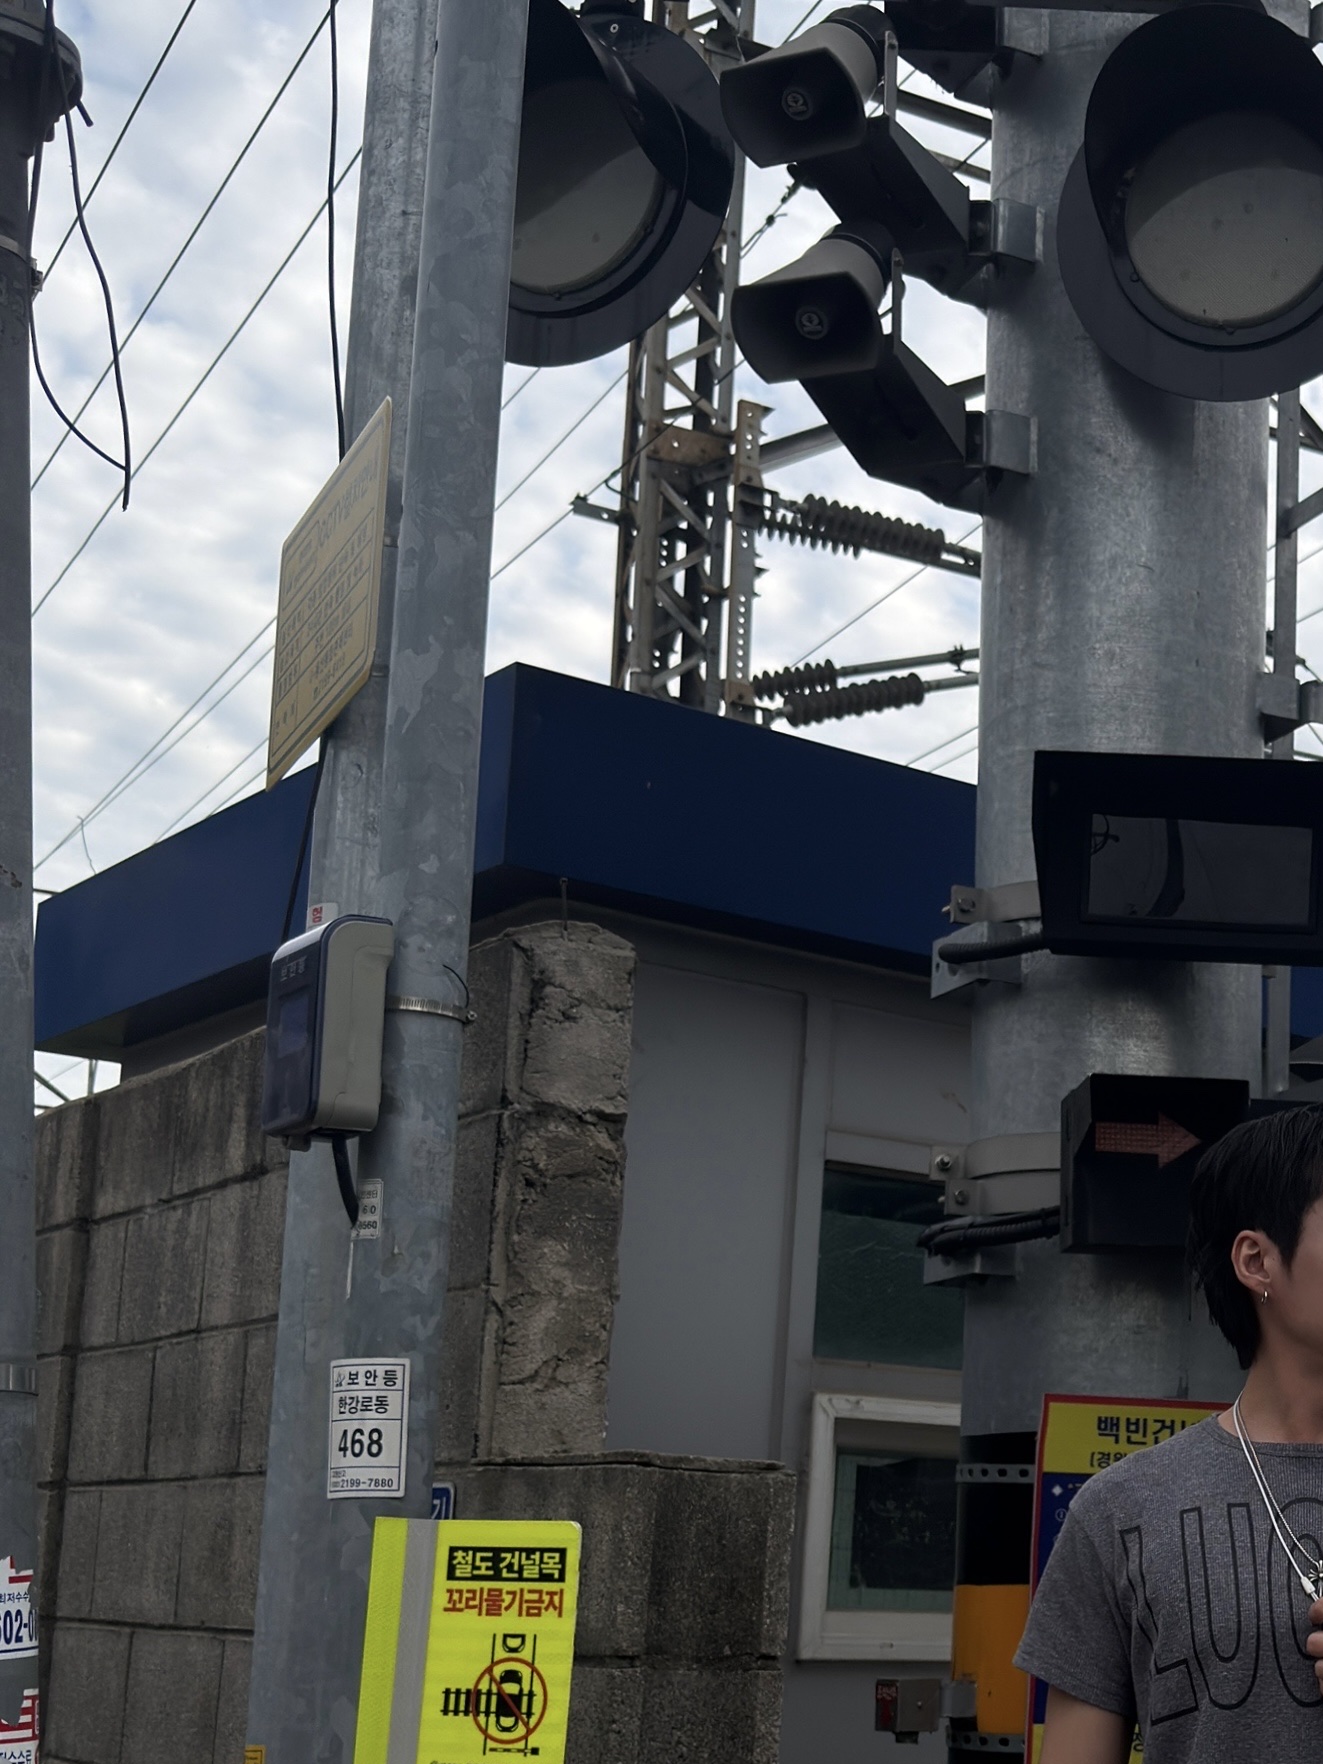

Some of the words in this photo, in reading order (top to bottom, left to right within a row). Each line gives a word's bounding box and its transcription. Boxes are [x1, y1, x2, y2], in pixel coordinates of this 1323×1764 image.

[347, 1369, 398, 1387] 보안등
[338, 1395, 389, 1414] 한강로동
[338, 1428, 383, 1458] 468
[1097, 1416, 1201, 1445] 백빈건
[452, 1550, 495, 1578] 철도
[499, 1551, 562, 1579] 건널목
[443, 1587, 565, 1618] 꼬리물기금지
